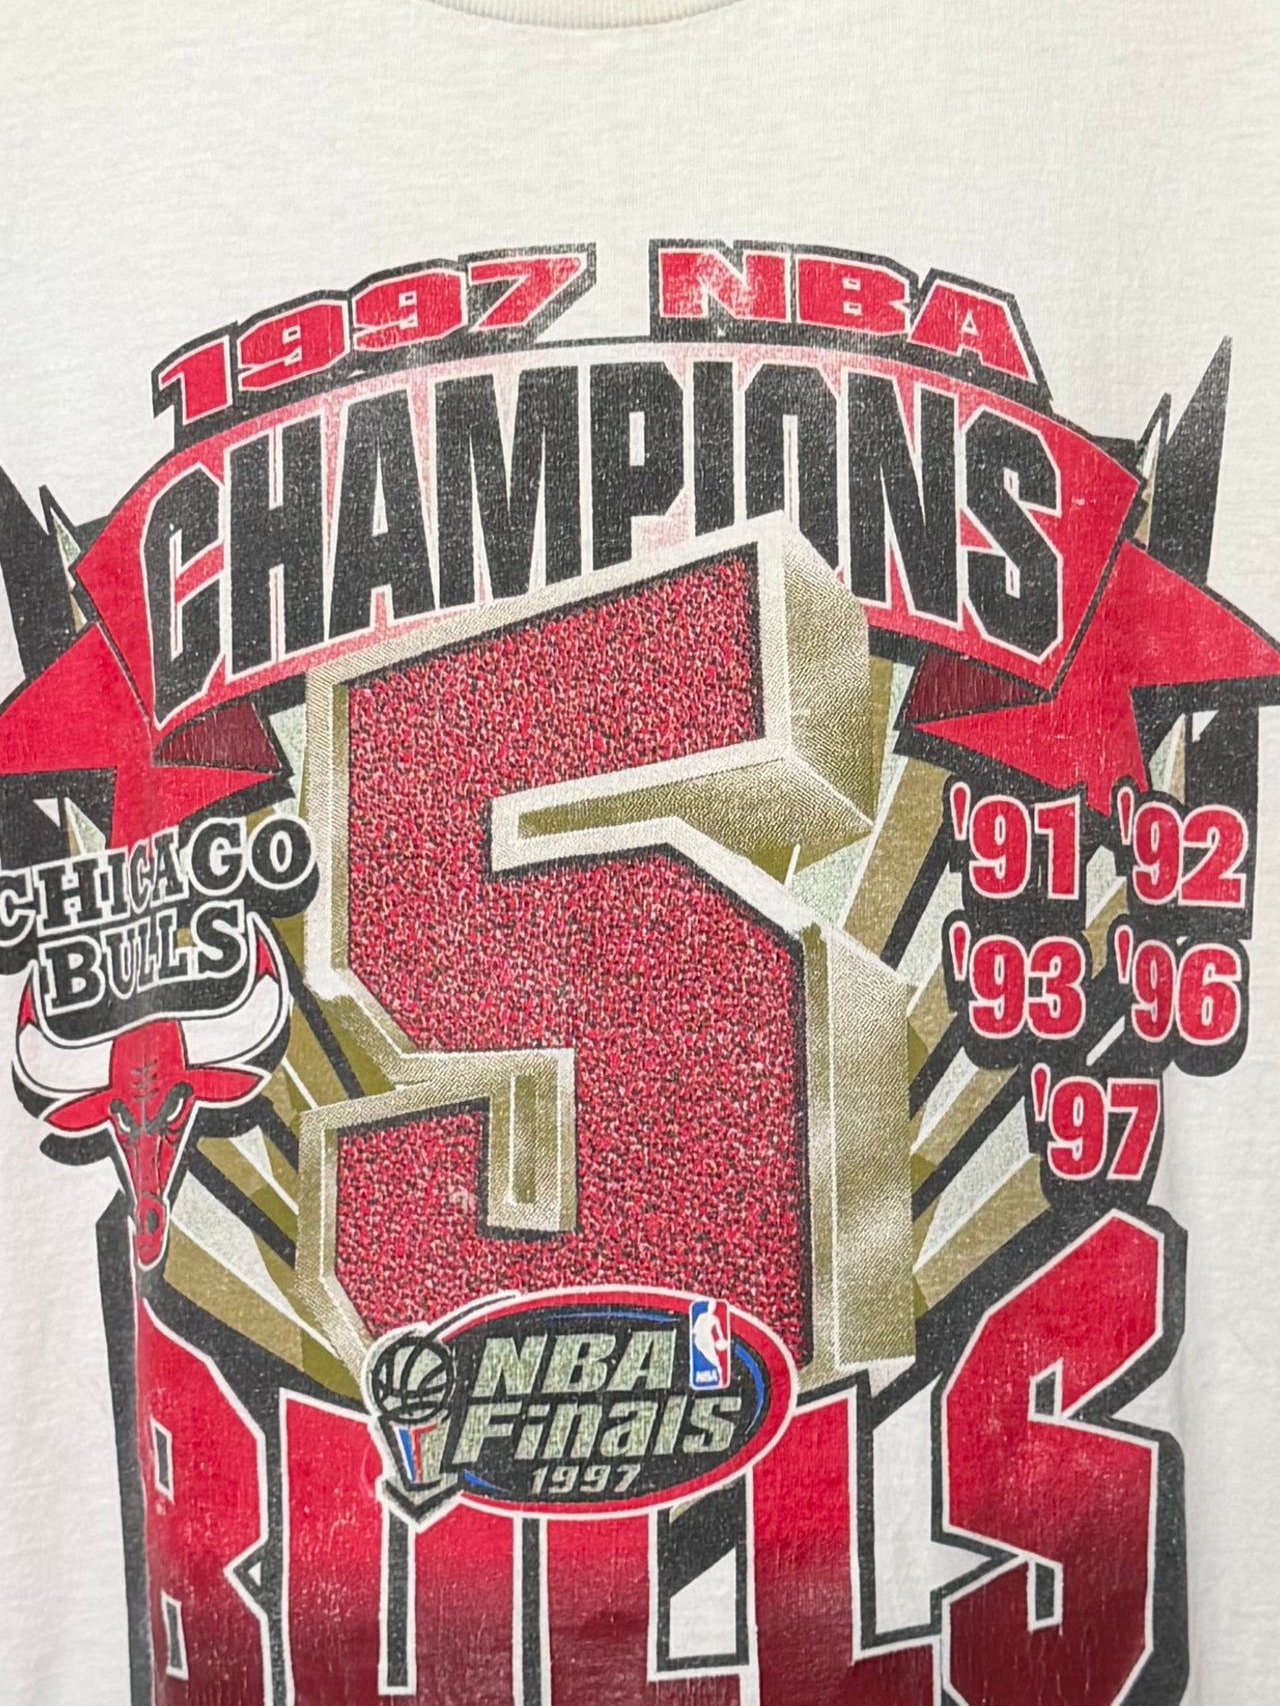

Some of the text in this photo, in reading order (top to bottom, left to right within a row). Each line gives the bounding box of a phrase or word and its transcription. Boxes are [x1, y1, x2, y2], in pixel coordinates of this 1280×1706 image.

[156, 247, 1040, 427] 1997 NBA
[140, 359, 1064, 730] CHAMPIONS
[950, 781, 1249, 909] '91 '92
[37, 899, 250, 1016] BULLS
[300, 513, 880, 1378] 5
[949, 920, 1243, 1046] '93 '96
[1031, 1062, 1161, 1181] '97
[471, 1327, 718, 1399] NBA NBA
[451, 1393, 743, 1466] Finals
[529, 1462, 643, 1495] 1997
